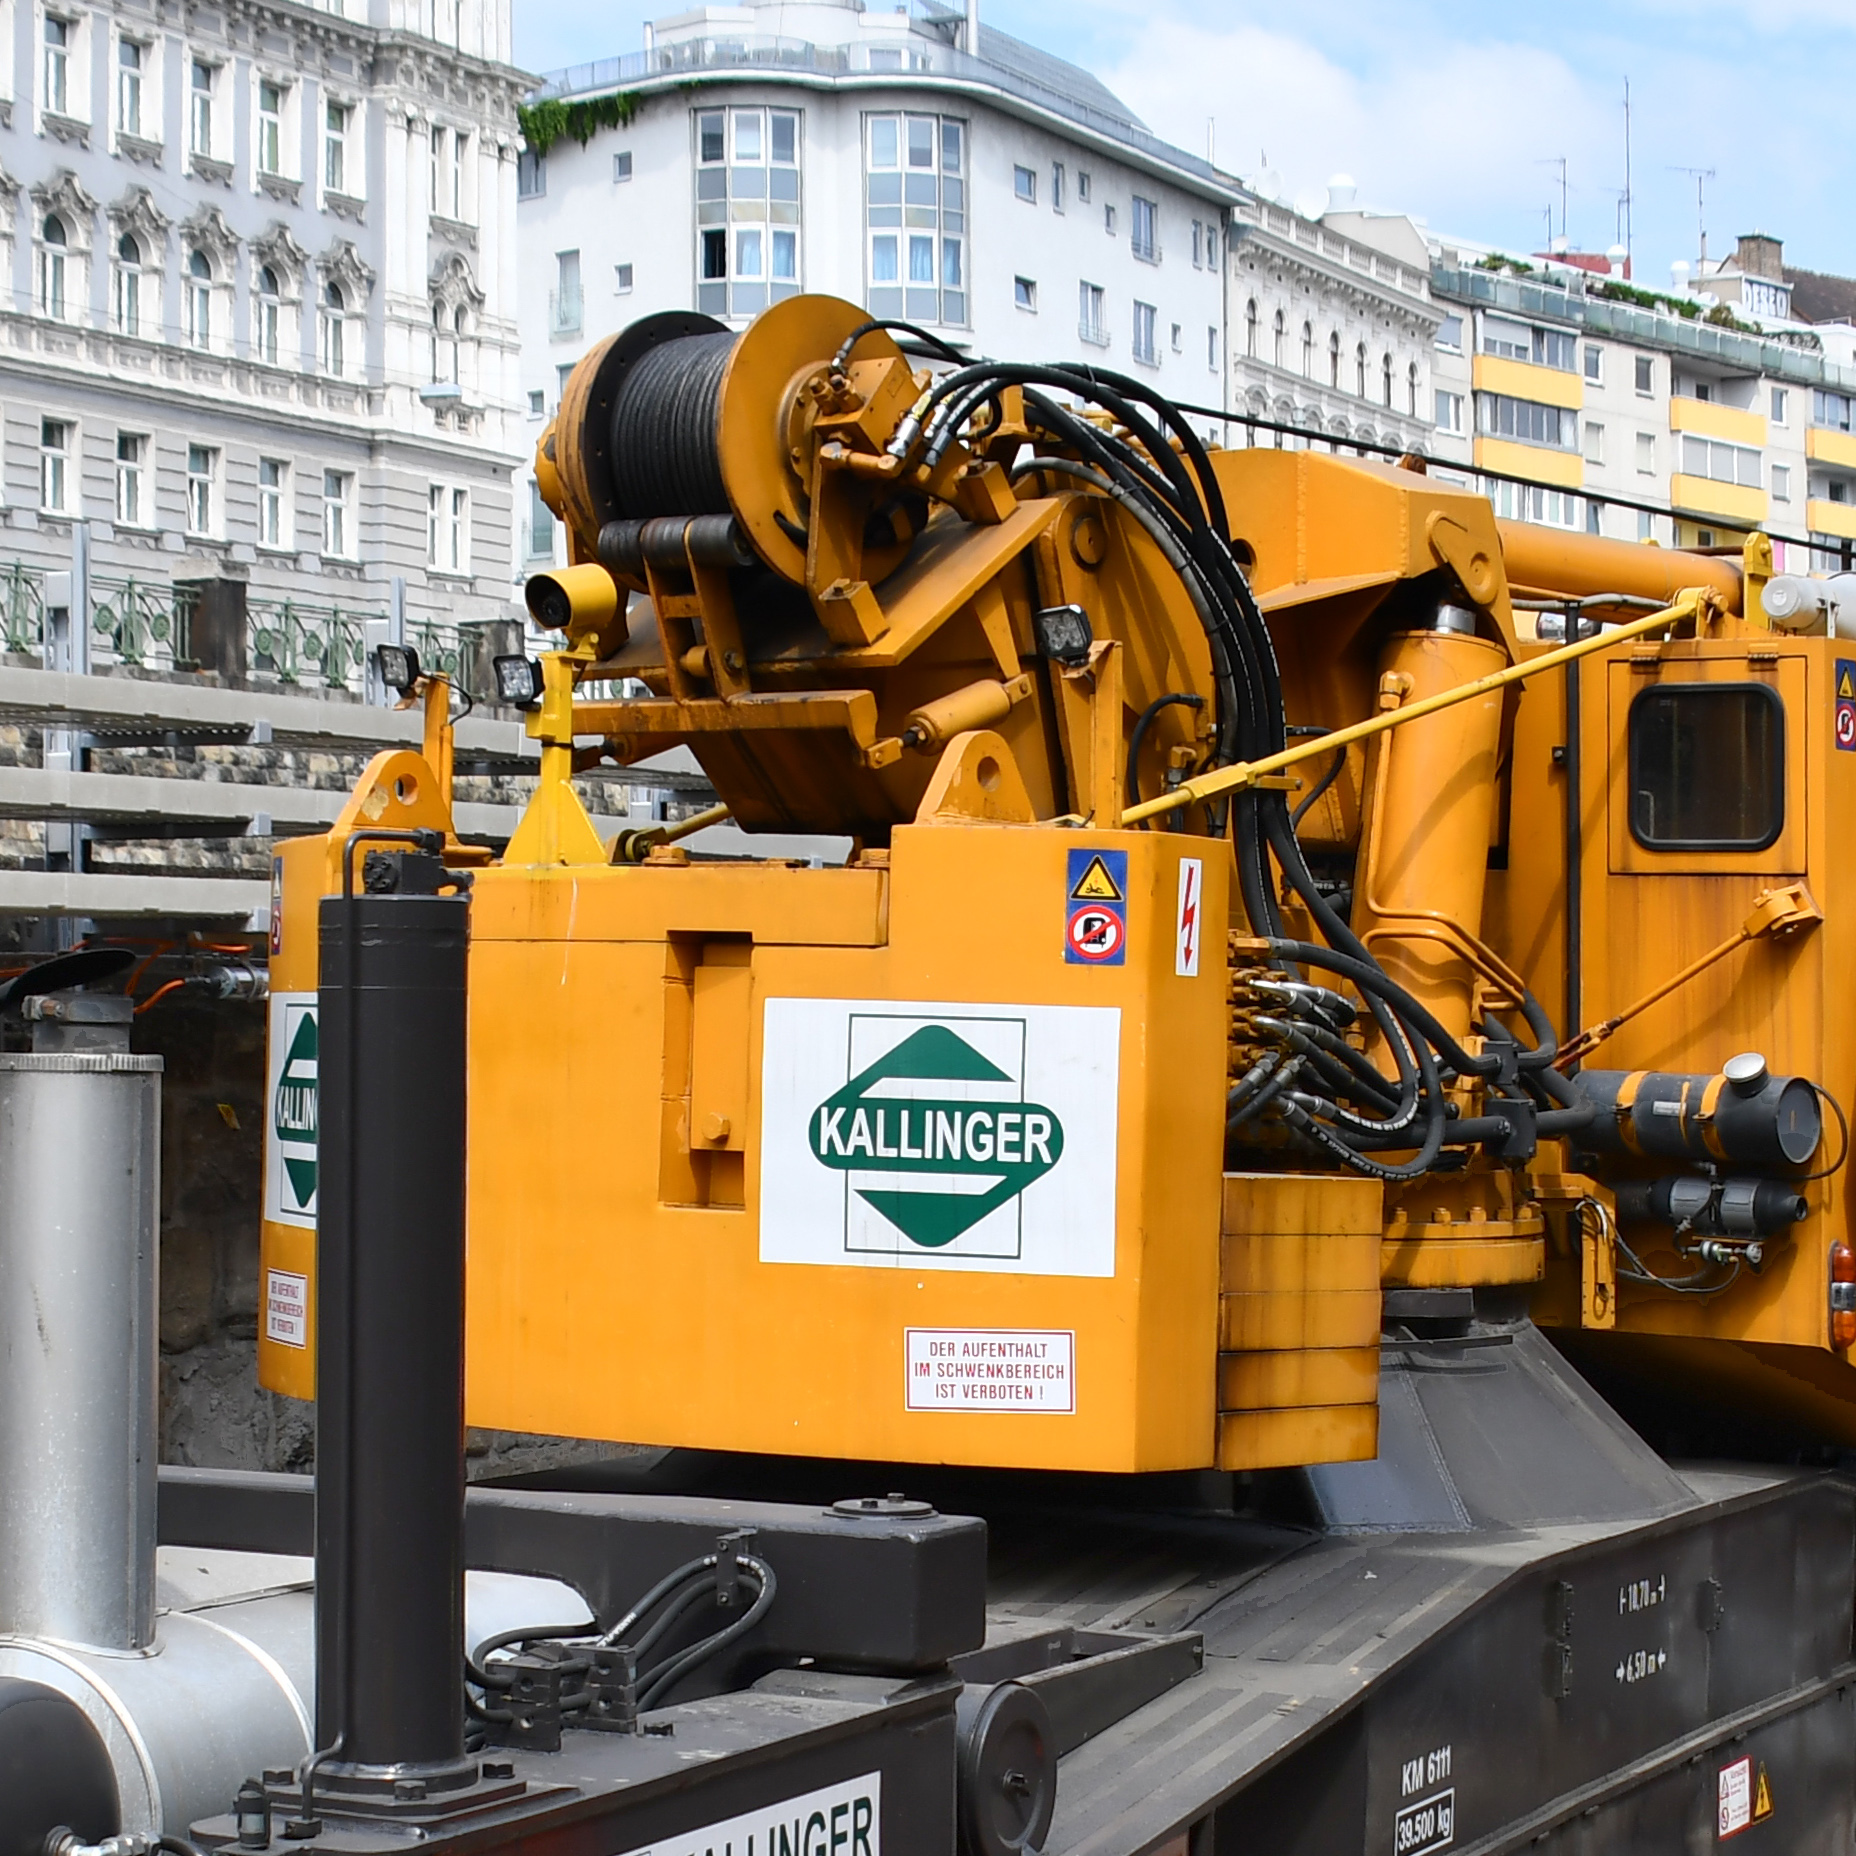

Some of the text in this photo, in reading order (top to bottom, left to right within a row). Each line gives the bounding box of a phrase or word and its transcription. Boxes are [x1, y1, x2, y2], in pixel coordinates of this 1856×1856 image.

[276, 1086, 317, 1130] KALLIN
[820, 1106, 1053, 1163] KALLINGER
[914, 1362, 1065, 1380] IM SCHWENKBEREICH
[929, 1341, 1048, 1358] DER AUFENTHALT
[935, 1383, 957, 1399] IST
[962, 1384, 1034, 1400] VERBOTEN
[1402, 1744, 1451, 1796] KM 6111
[1398, 1803, 1451, 1851] 39.500 kg
